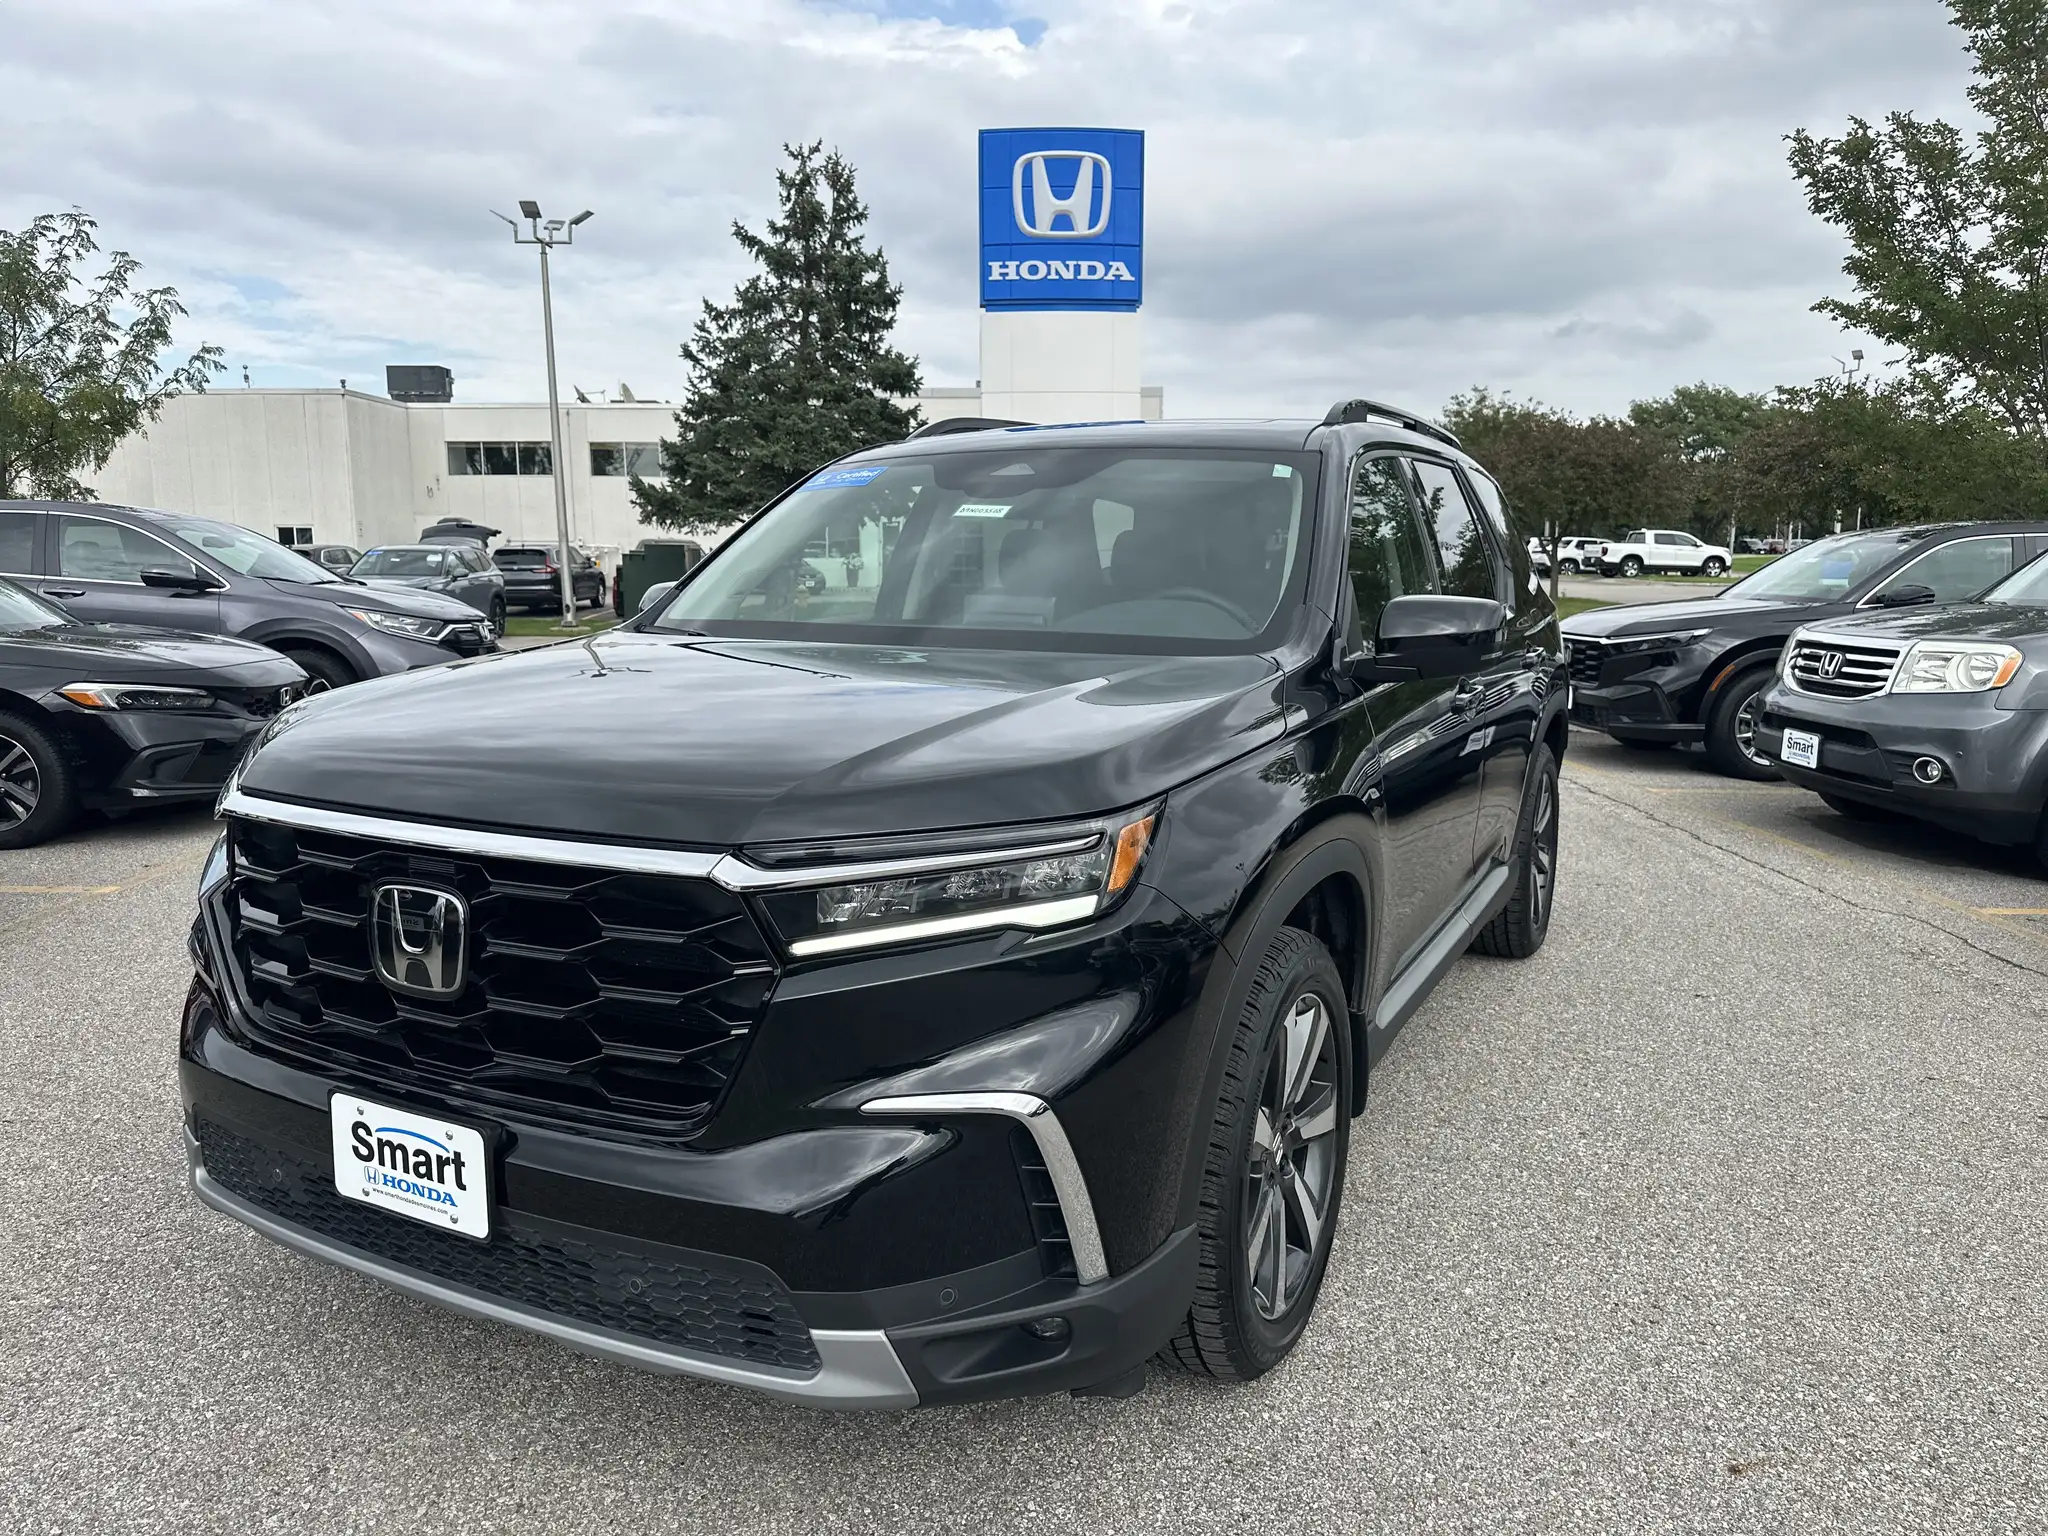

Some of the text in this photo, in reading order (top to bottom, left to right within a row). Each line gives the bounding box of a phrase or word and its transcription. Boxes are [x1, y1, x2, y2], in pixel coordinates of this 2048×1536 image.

[987, 260, 1136, 282] HONDA
[1786, 736, 1814, 756] Smart
[351, 1120, 467, 1192] Smart
[381, 1172, 458, 1208] HONDA
